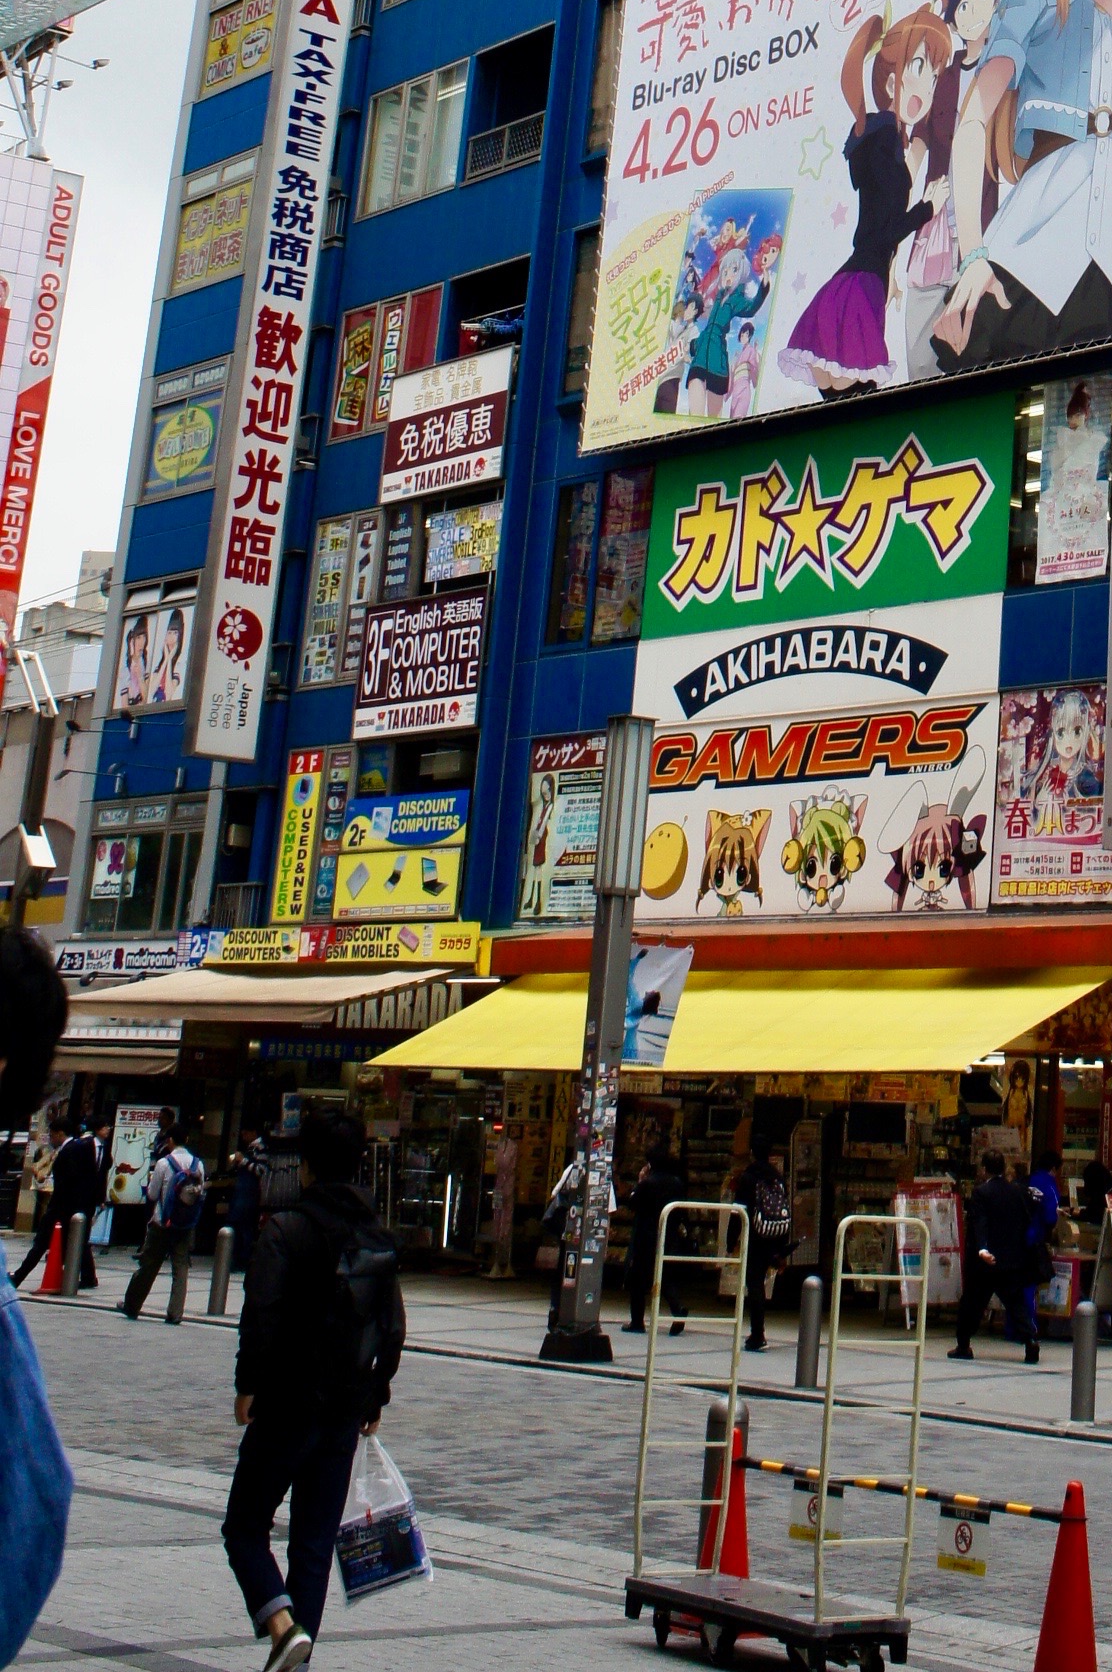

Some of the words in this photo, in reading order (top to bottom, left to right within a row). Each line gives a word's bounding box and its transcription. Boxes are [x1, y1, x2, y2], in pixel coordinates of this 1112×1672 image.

[205, 52, 237, 88] COMICS
[242, 44, 264, 62] cafe
[632, 66, 707, 111] Blu-ray
[714, 49, 761, 83] Disc
[768, 22, 820, 65] BOX
[622, 96, 722, 184] 4.26
[727, 109, 762, 139] ON
[764, 87, 815, 130] SALE
[702, 171, 735, 203] Pictures
[45, 184, 75, 269] ADULT
[28, 271, 62, 368] GOODS
[338, 320, 372, 426] 麻雀
[374, 307, 403, 414] ウエルカム
[618, 340, 684, 406] 好評放送中!
[17, 409, 41, 478] LOVE
[413, 459, 472, 493] TAKARADA
[0, 485, 28, 573] MERCI
[440, 526, 465, 547] SALE
[395, 603, 442, 636] English
[442, 597, 484, 625] 英語版
[364, 618, 394, 696] 3F
[391, 625, 481, 669] COMPUTER
[388, 671, 402, 700] &
[405, 660, 479, 697] MOBILE
[703, 628, 912, 702] AKIHABARA
[207, 694, 224, 729] Shop
[223, 675, 240, 730] Tax-free
[387, 702, 446, 730] TAKARADA
[295, 753, 319, 773] 2F
[535, 742, 586, 769] ゲッサン
[649, 702, 989, 793] GAMERS
[908, 762, 953, 775] ANIBRO
[391, 815, 461, 834] COMPUTERS
[396, 797, 457, 817] DISCOUNT
[347, 824, 367, 847] 2F
[276, 809, 299, 918] COMPUTERS
[191, 934, 206, 958] 2F
[221, 944, 282, 961] COMPUTERS
[228, 930, 279, 945] DISCOUNT
[326, 944, 350, 959] GSM
[352, 942, 401, 958] MOBILES
[335, 927, 391, 943] DISCOUNT
[438, 937, 472, 950] タカラダ
[125, 947, 178, 970] maidreamin
